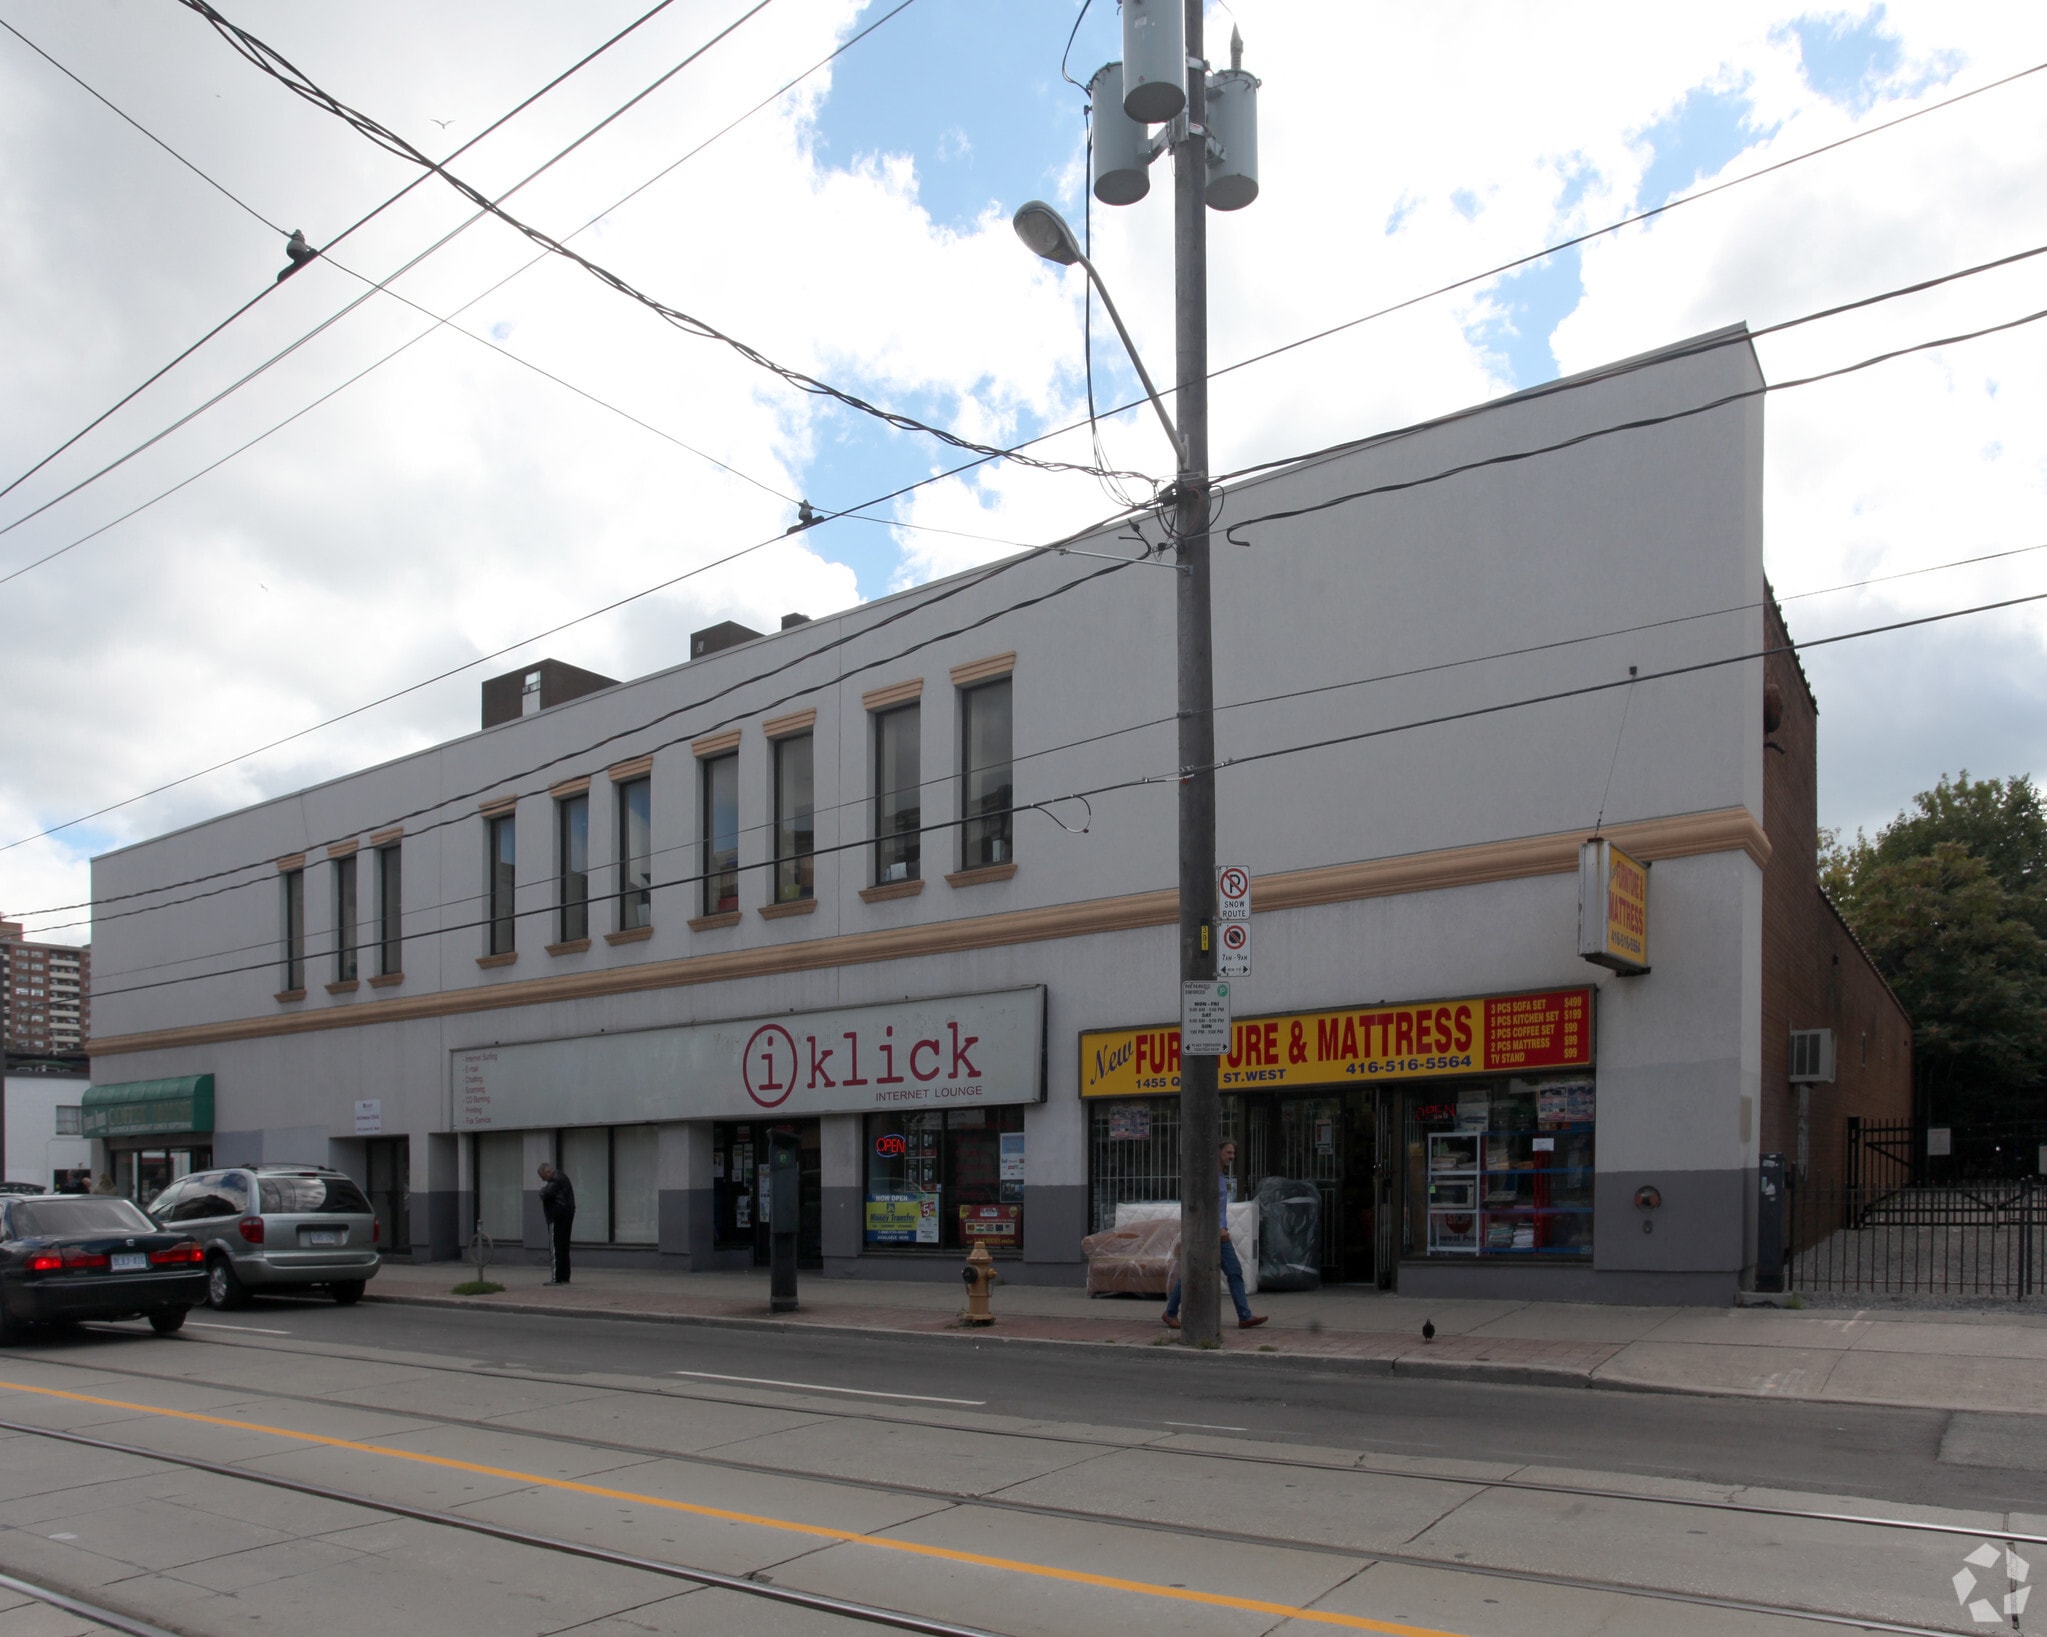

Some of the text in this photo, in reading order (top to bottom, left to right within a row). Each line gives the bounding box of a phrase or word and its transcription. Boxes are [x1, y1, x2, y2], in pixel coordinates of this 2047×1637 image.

[1222, 909, 1247, 918] ROUTE
[1224, 901, 1246, 909] SNOW
[1608, 889, 1644, 936] MATTRESS
[1490, 1003, 1496, 1014] 3
[1497, 1002, 1512, 1014] PCS
[1512, 1000, 1531, 1012] SOFA
[1532, 998, 1547, 1011] SET
[1490, 1009, 1582, 1028] 5 PCS KITCHEN SET $199
[1490, 1022, 1578, 1040] 3 PCS COFFEE SET $99
[1090, 1005, 1473, 1086] New FURURE & MATTRESS
[1490, 1035, 1578, 1053] 2 PCS MATTRESS $99
[806, 1021, 982, 1089] klick
[1490, 1047, 1578, 1065] TV STAND $99
[1345, 1054, 1473, 1075] 416-516-5564
[1135, 1077, 1167, 1089] 1455
[1222, 1068, 1287, 1084] ST.WEST
[875, 1085, 984, 1103] INTERNET LOUNGE
[875, 1136, 906, 1154] OPEN
[875, 1194, 908, 1202] NOW OPEN
[890, 1211, 915, 1222] Transfer
